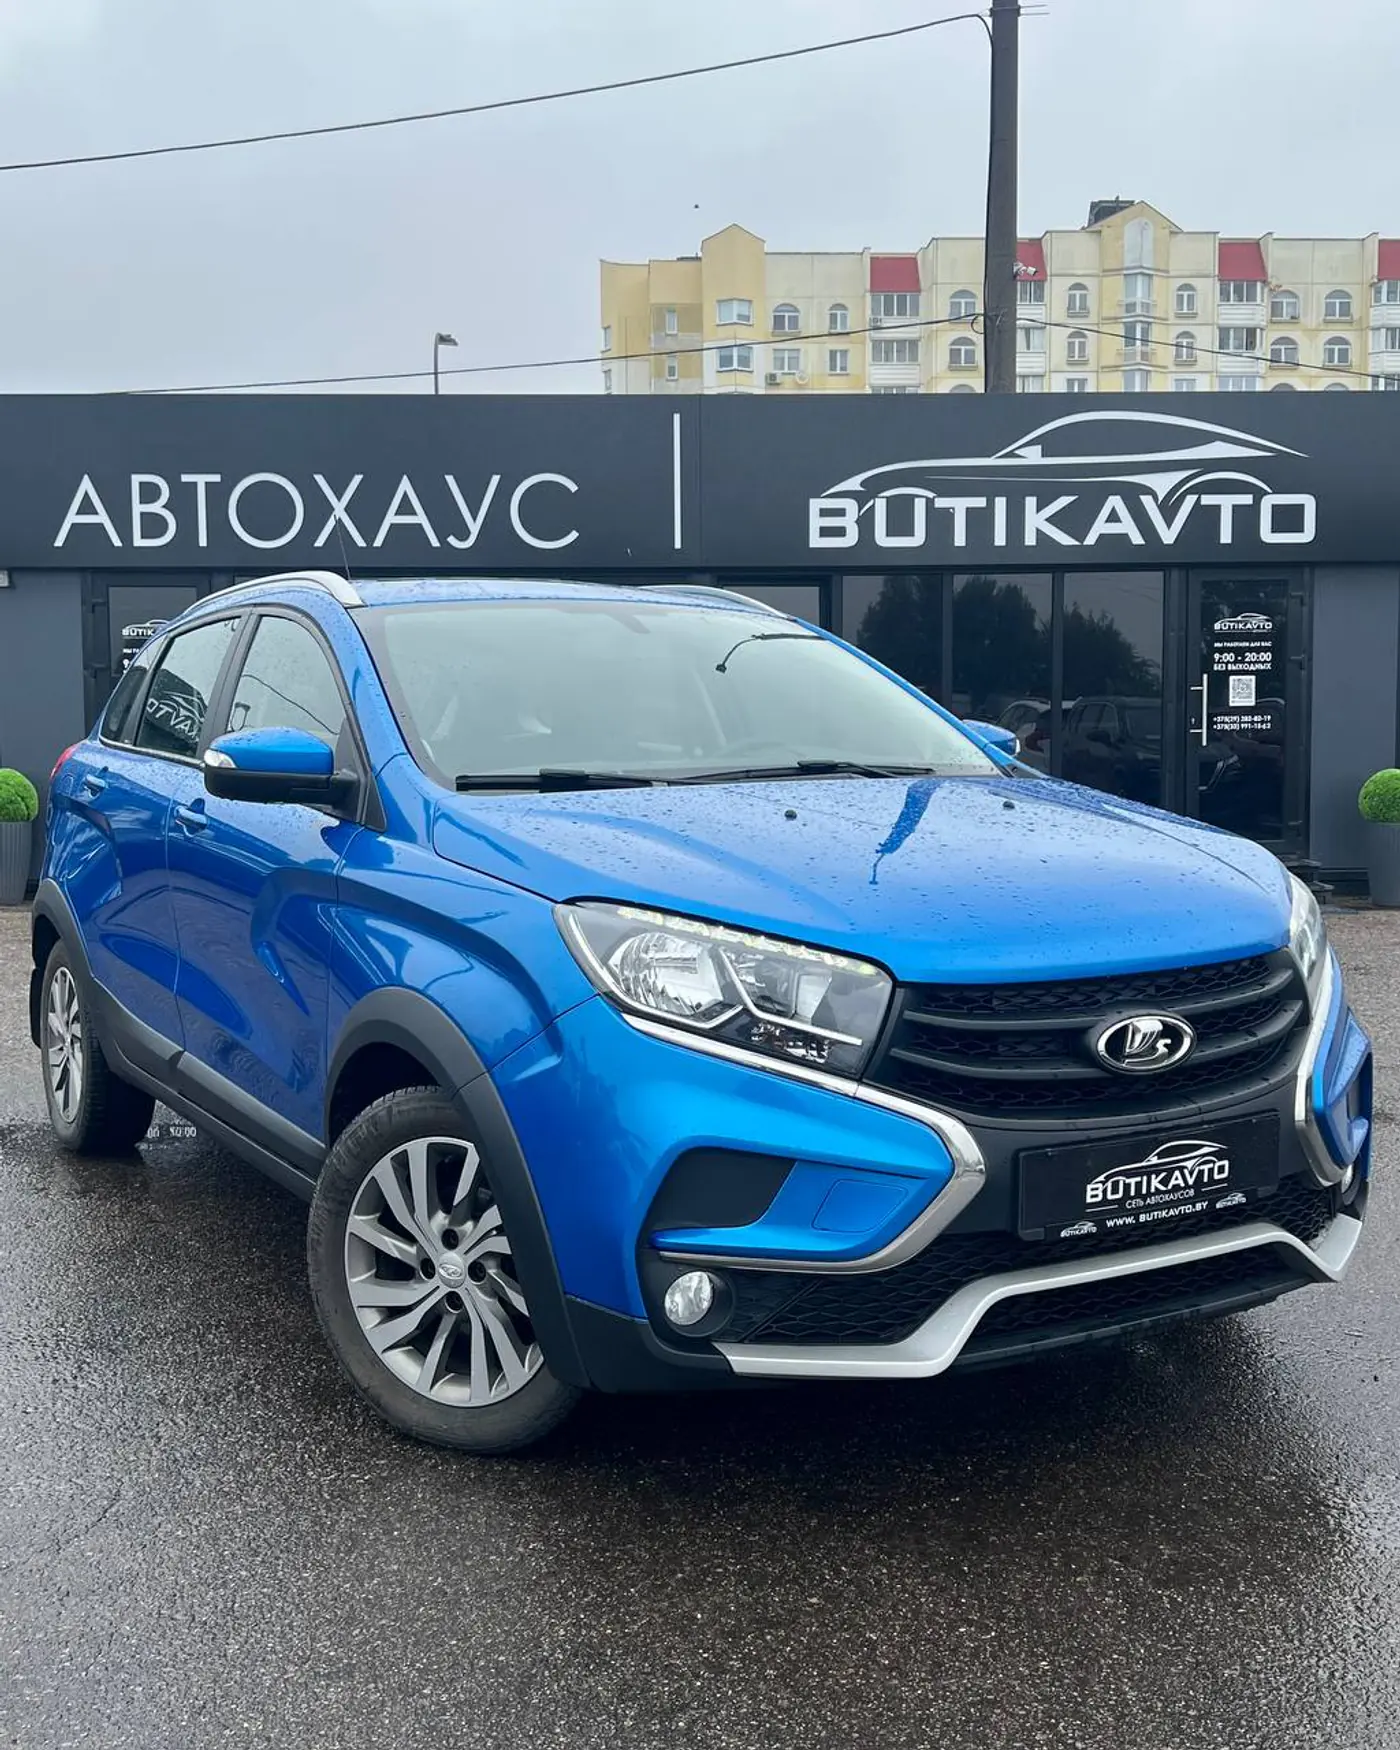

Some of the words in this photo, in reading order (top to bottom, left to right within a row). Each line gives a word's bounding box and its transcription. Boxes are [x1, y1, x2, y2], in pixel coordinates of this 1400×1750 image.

[54, 472, 580, 550] АВТОХАУС
[808, 493, 1317, 548] BUTIKAVTO
[122, 627, 154, 636] BUTIK
[1214, 622, 1273, 630] BUTIKAVTO
[1213, 652, 1235, 662] 9:00
[1244, 651, 1272, 662] 20:00
[1213, 663, 1226, 671] БЕЗ
[1227, 662, 1272, 671] ВЫХОДНЫХ
[1085, 1160, 1229, 1204] BUTIKAVTO
[1125, 1198, 1144, 1209] СЕТЬ
[1145, 1188, 1195, 1206] АВТОХАУСОВ
[1105, 1215, 1136, 1228] WWW.
[1138, 1200, 1209, 1223] BUTIKAVTO.BY
